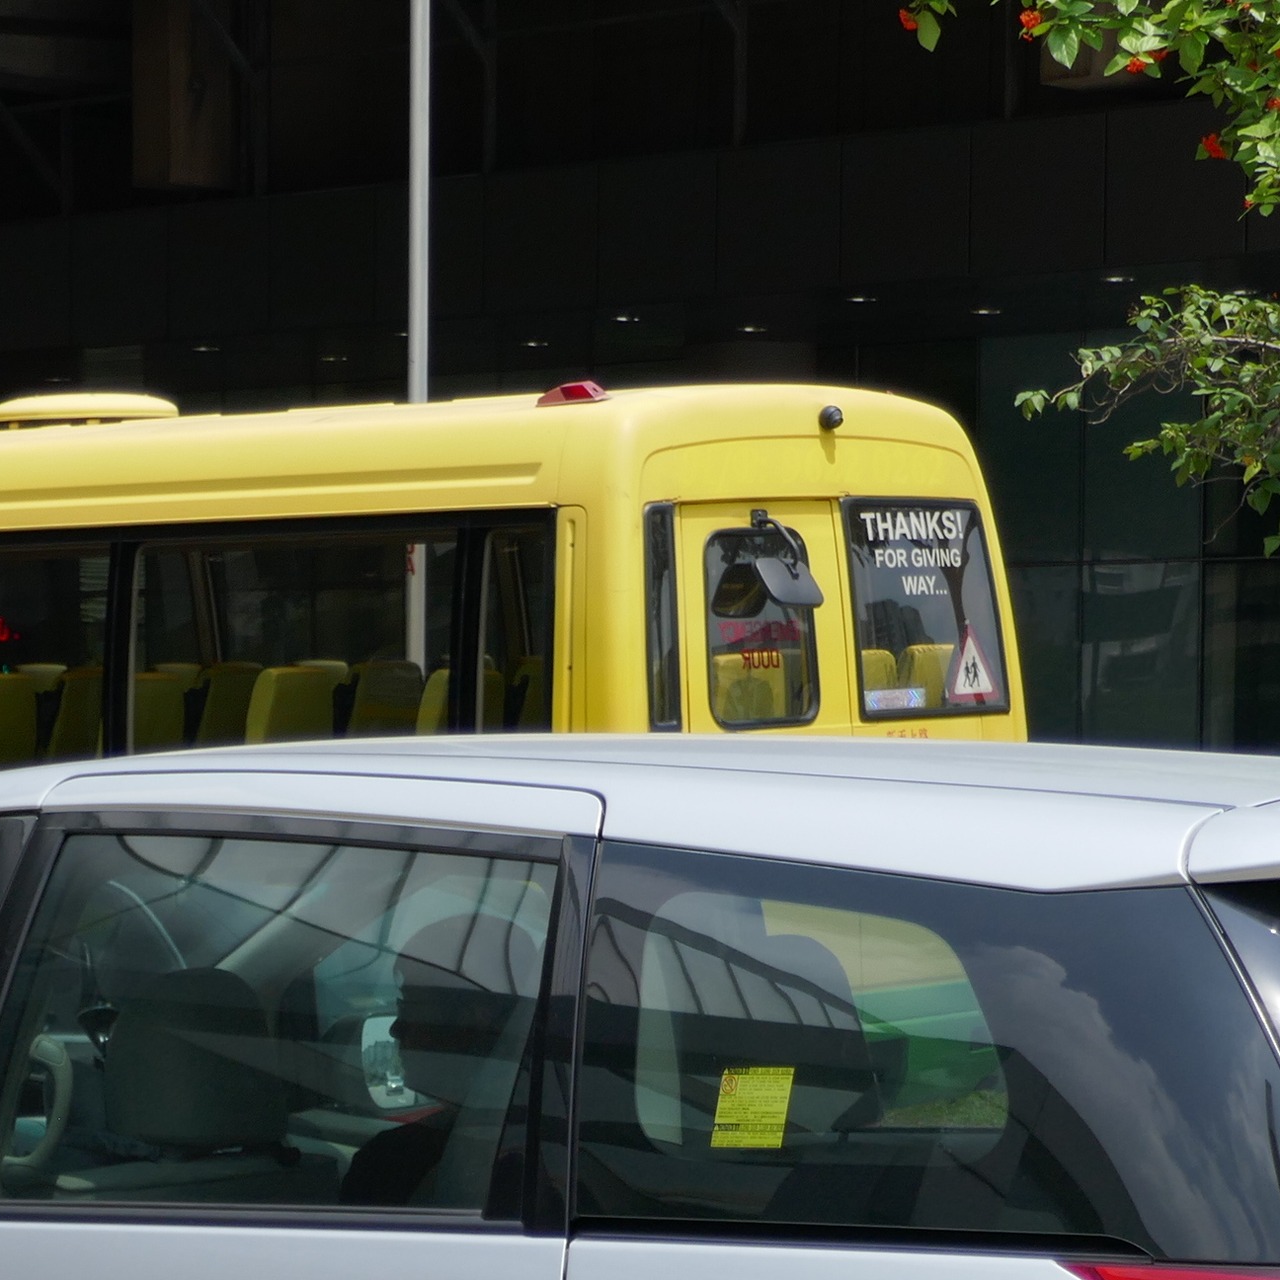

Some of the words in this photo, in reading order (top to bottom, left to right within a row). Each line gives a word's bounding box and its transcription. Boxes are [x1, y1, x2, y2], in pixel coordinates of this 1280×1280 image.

[860, 511, 964, 541] THANKS!
[874, 548, 908, 568] FOR
[911, 548, 962, 568] GIVING
[902, 576, 948, 595] WAY...
